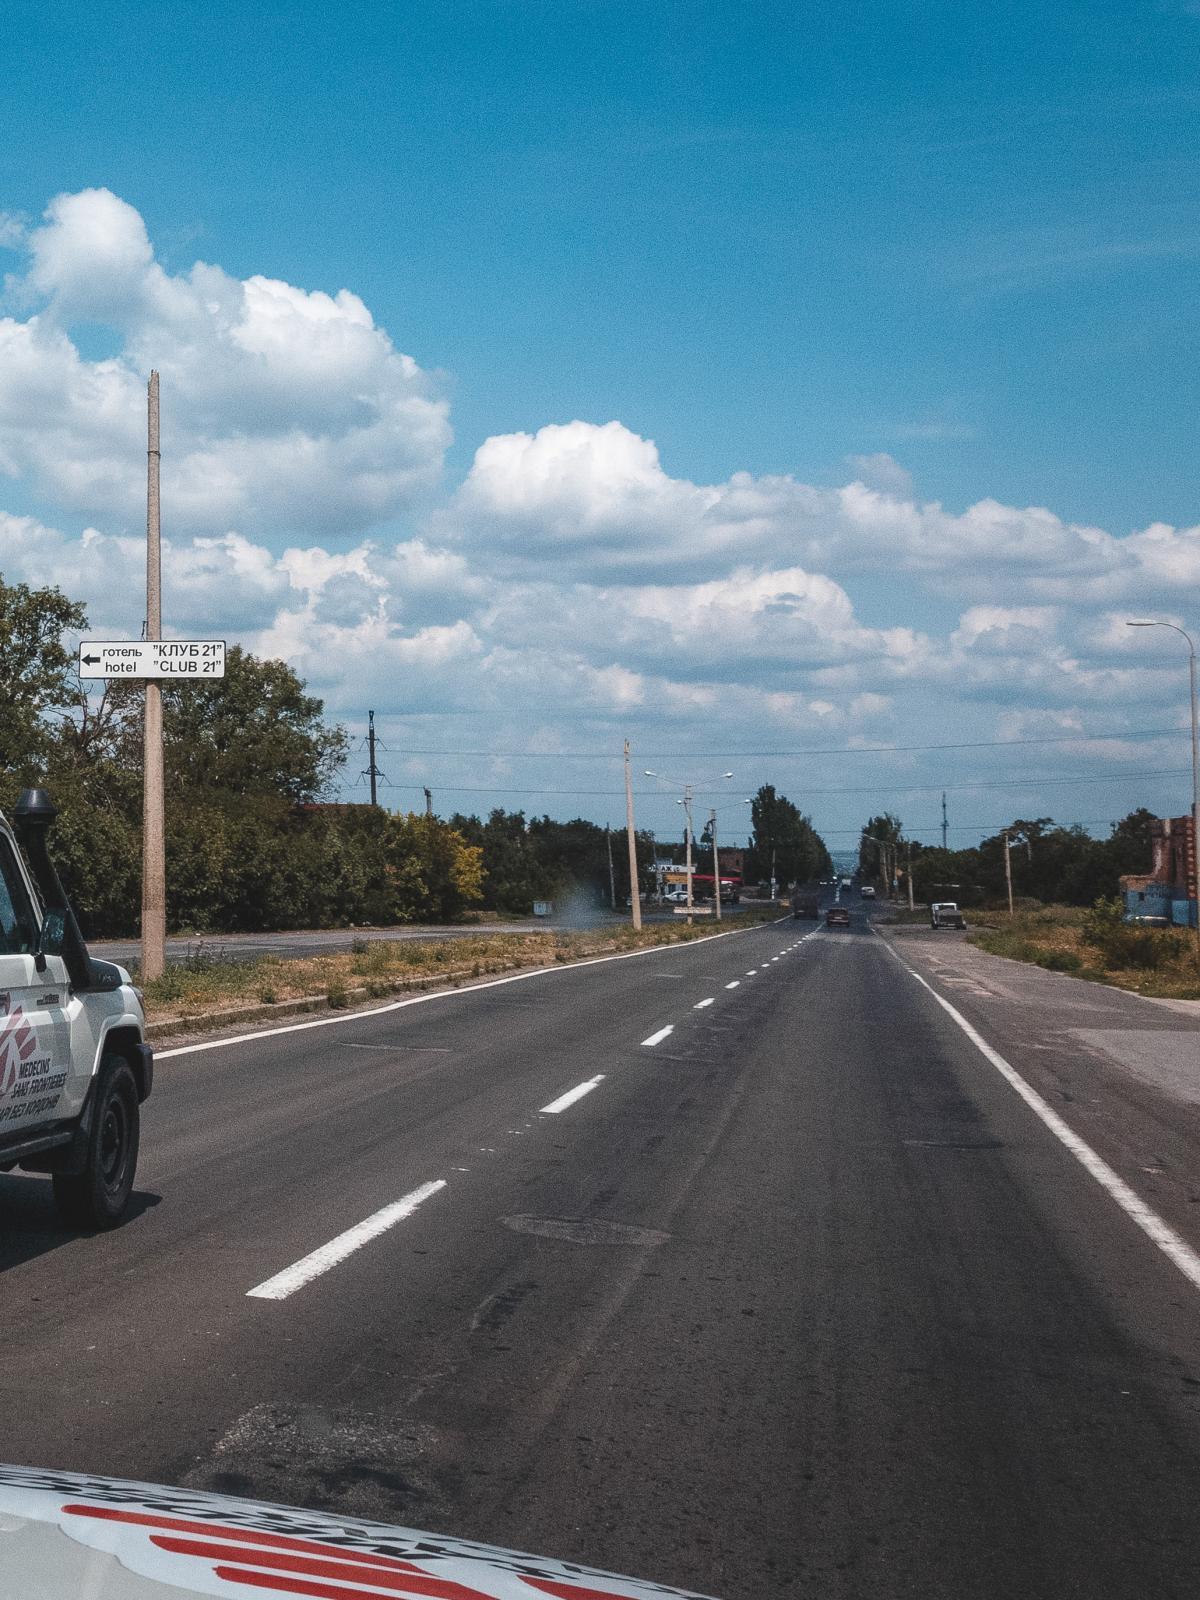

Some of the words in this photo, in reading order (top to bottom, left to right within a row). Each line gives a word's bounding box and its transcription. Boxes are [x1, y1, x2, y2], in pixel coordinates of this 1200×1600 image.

[102, 648, 143, 657] готель
[105, 661, 137, 673] hotel
[20, 1058, 51, 1079] MEDECINS
